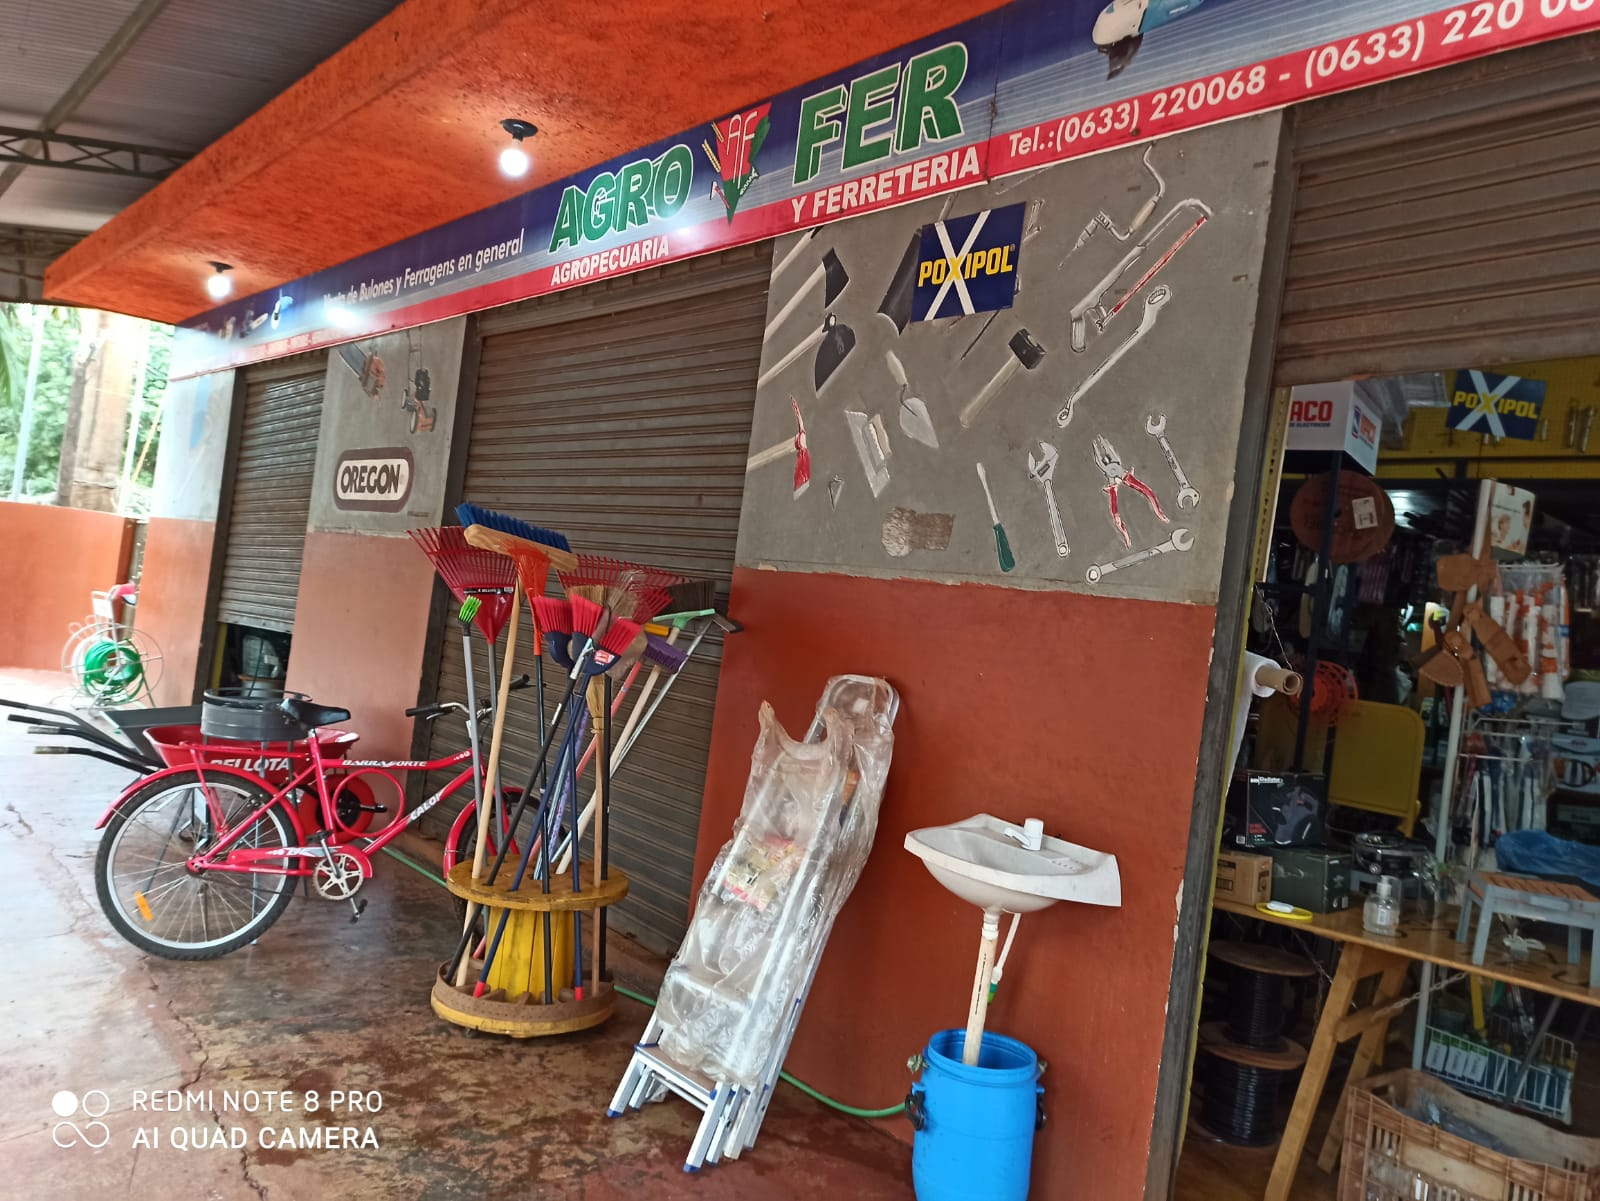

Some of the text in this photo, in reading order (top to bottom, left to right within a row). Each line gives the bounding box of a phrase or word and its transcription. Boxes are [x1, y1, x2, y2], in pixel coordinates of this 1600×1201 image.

[1151, 65, 1266, 121] 220068
[1305, 21, 1426, 89] (0633)
[1441, 0, 1525, 46] 220
[791, 41, 968, 187] FER
[548, 143, 694, 256] AGRO
[791, 147, 980, 223] Y FERRETERIA
[360, 279, 394, 301] Bulones
[395, 276, 403, 297] y
[404, 257, 455, 288] Ferragens
[458, 252, 472, 272] en
[475, 228, 524, 272] general
[550, 235, 670, 287] AGROPECUARIA
[918, 245, 1013, 288] POXIPOL
[1453, 390, 1538, 420] POXIPOL
[341, 464, 401, 495] OREGON
